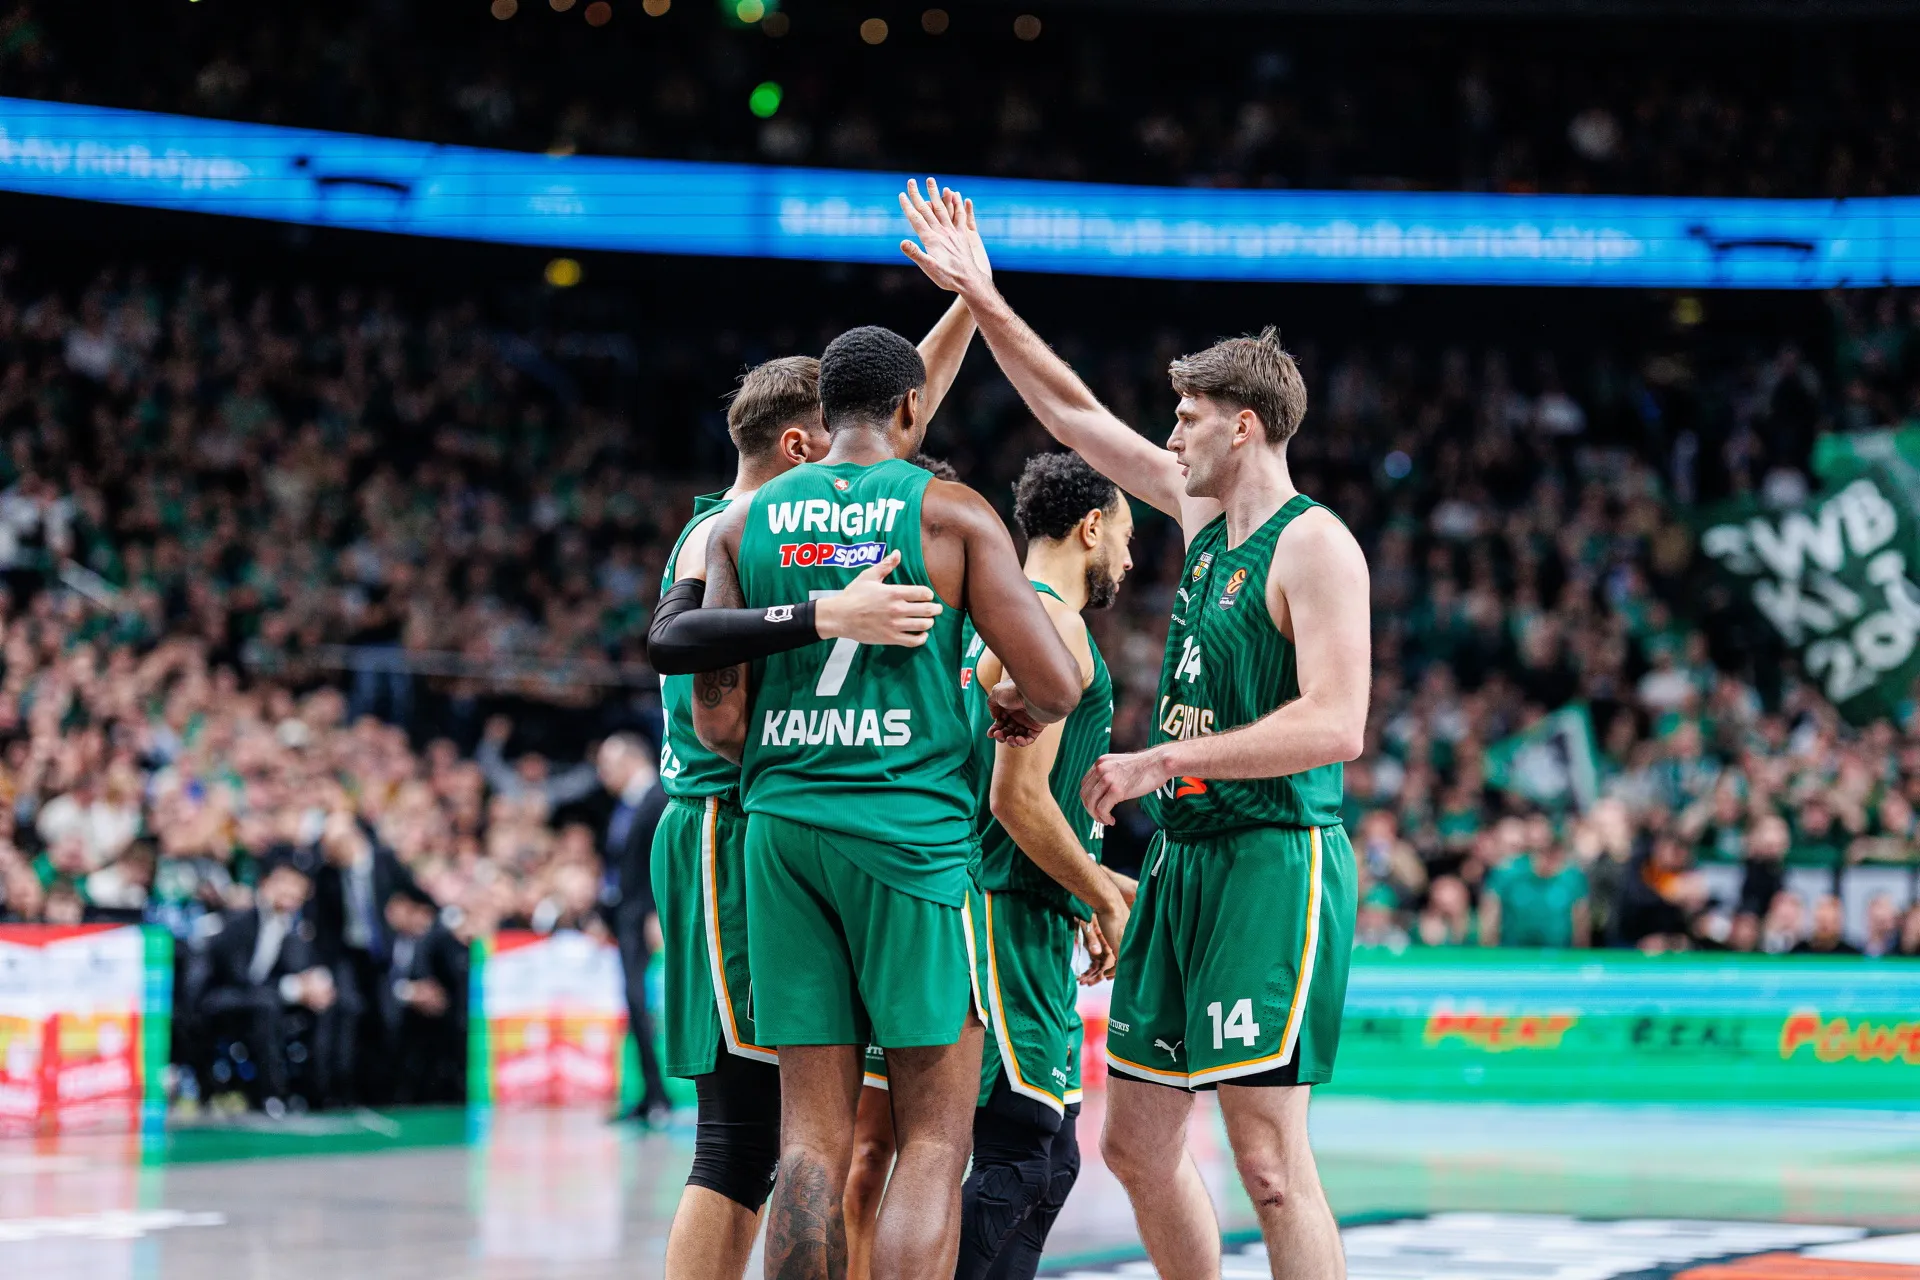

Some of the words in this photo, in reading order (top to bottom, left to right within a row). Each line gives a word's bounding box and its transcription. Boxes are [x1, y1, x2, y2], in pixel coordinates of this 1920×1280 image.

[768, 498, 905, 537] WRIGHT
[1174, 635, 1201, 684] 14
[762, 709, 912, 746] KAUNAS
[1207, 998, 1260, 1050] 14
